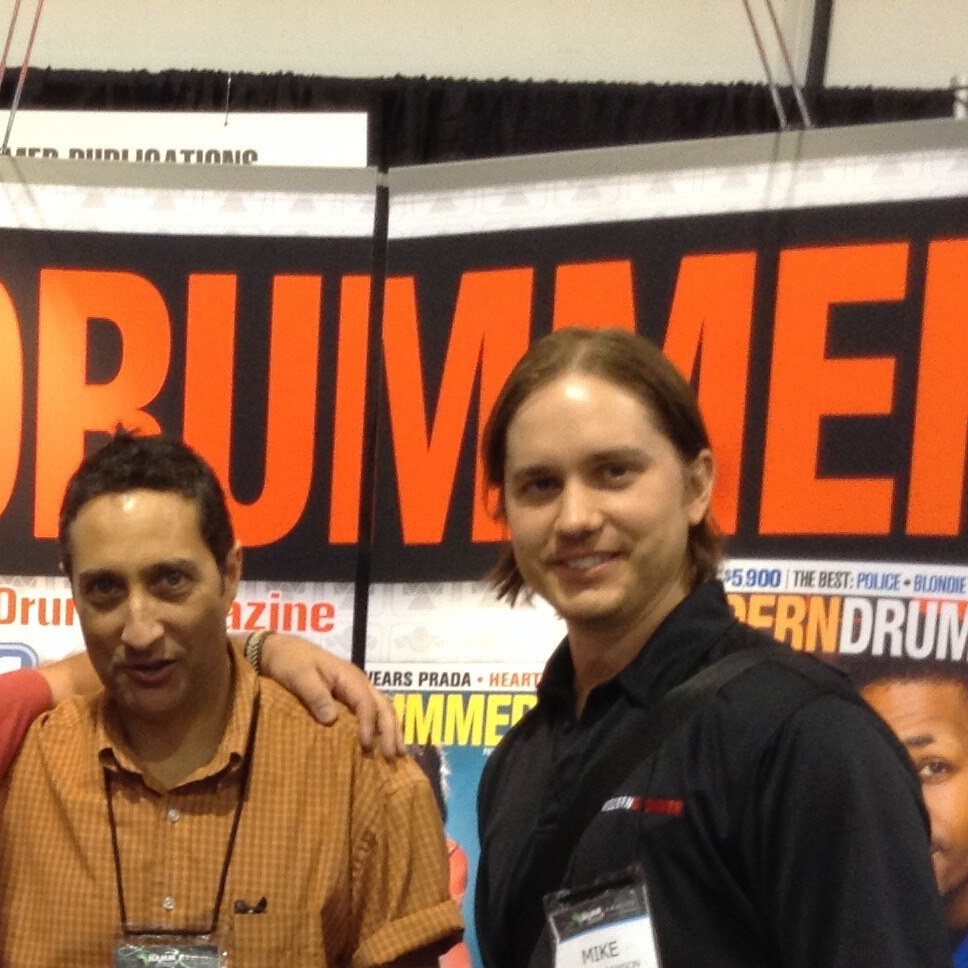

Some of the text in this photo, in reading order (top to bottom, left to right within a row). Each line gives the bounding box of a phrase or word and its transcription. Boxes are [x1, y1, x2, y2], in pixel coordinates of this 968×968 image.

[793, 569, 815, 587] THE
[856, 573, 901, 591] POLICE
[418, 672, 472, 688] PRADA
[582, 940, 620, 965] MIKE
